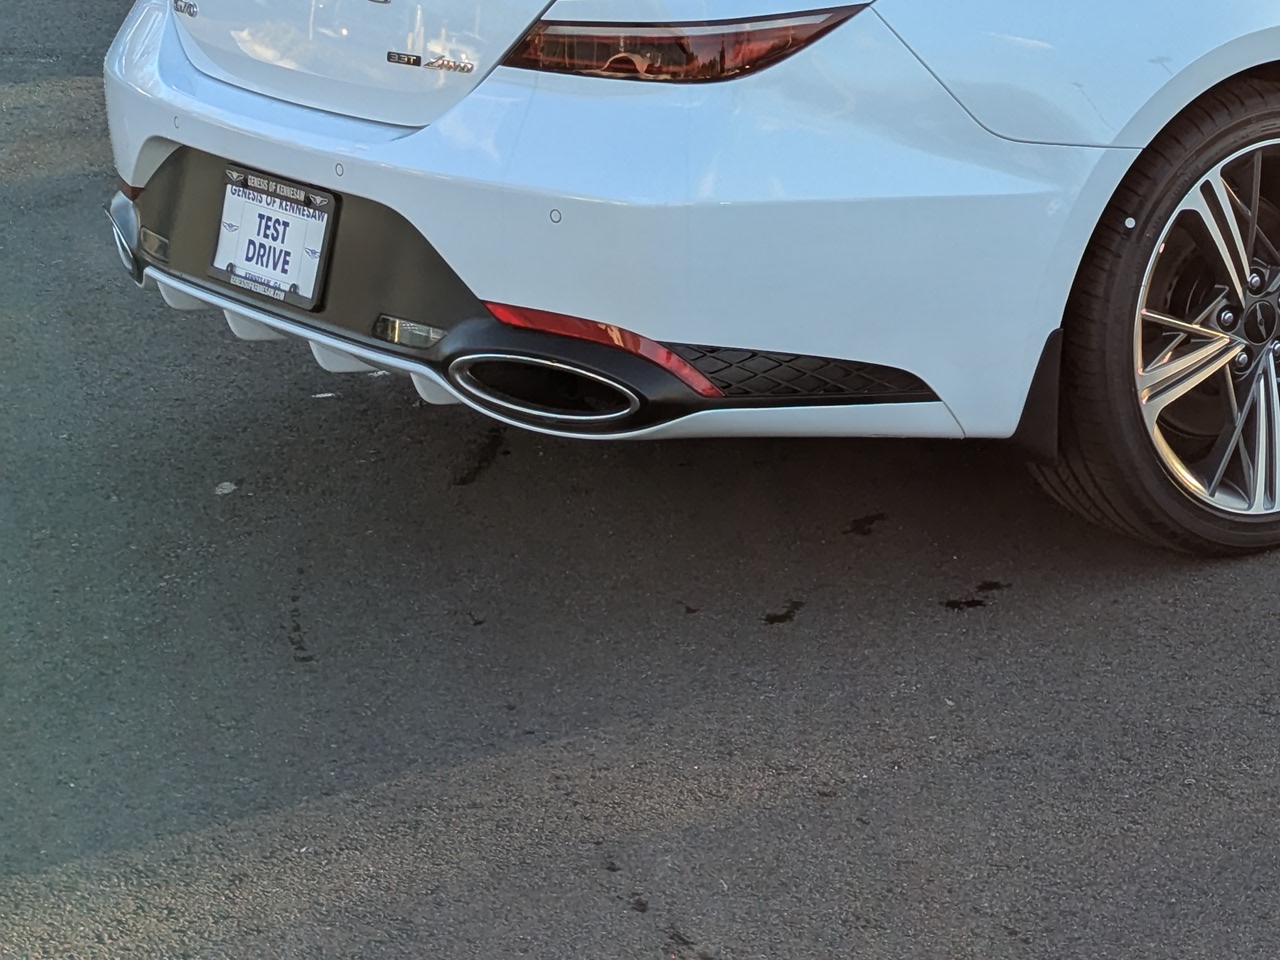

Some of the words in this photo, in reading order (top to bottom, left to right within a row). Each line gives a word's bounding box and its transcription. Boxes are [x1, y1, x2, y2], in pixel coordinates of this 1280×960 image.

[230, 185, 264, 204] GENESIS
[265, 195, 277, 208] OF
[278, 198, 326, 223] KENNESAW
[247, 174, 269, 192] GENESIS
[268, 181, 277, 193] OF
[277, 183, 306, 202] KENNESAW
[256, 212, 290, 245] TEST
[244, 238, 292, 276] DRIVE
